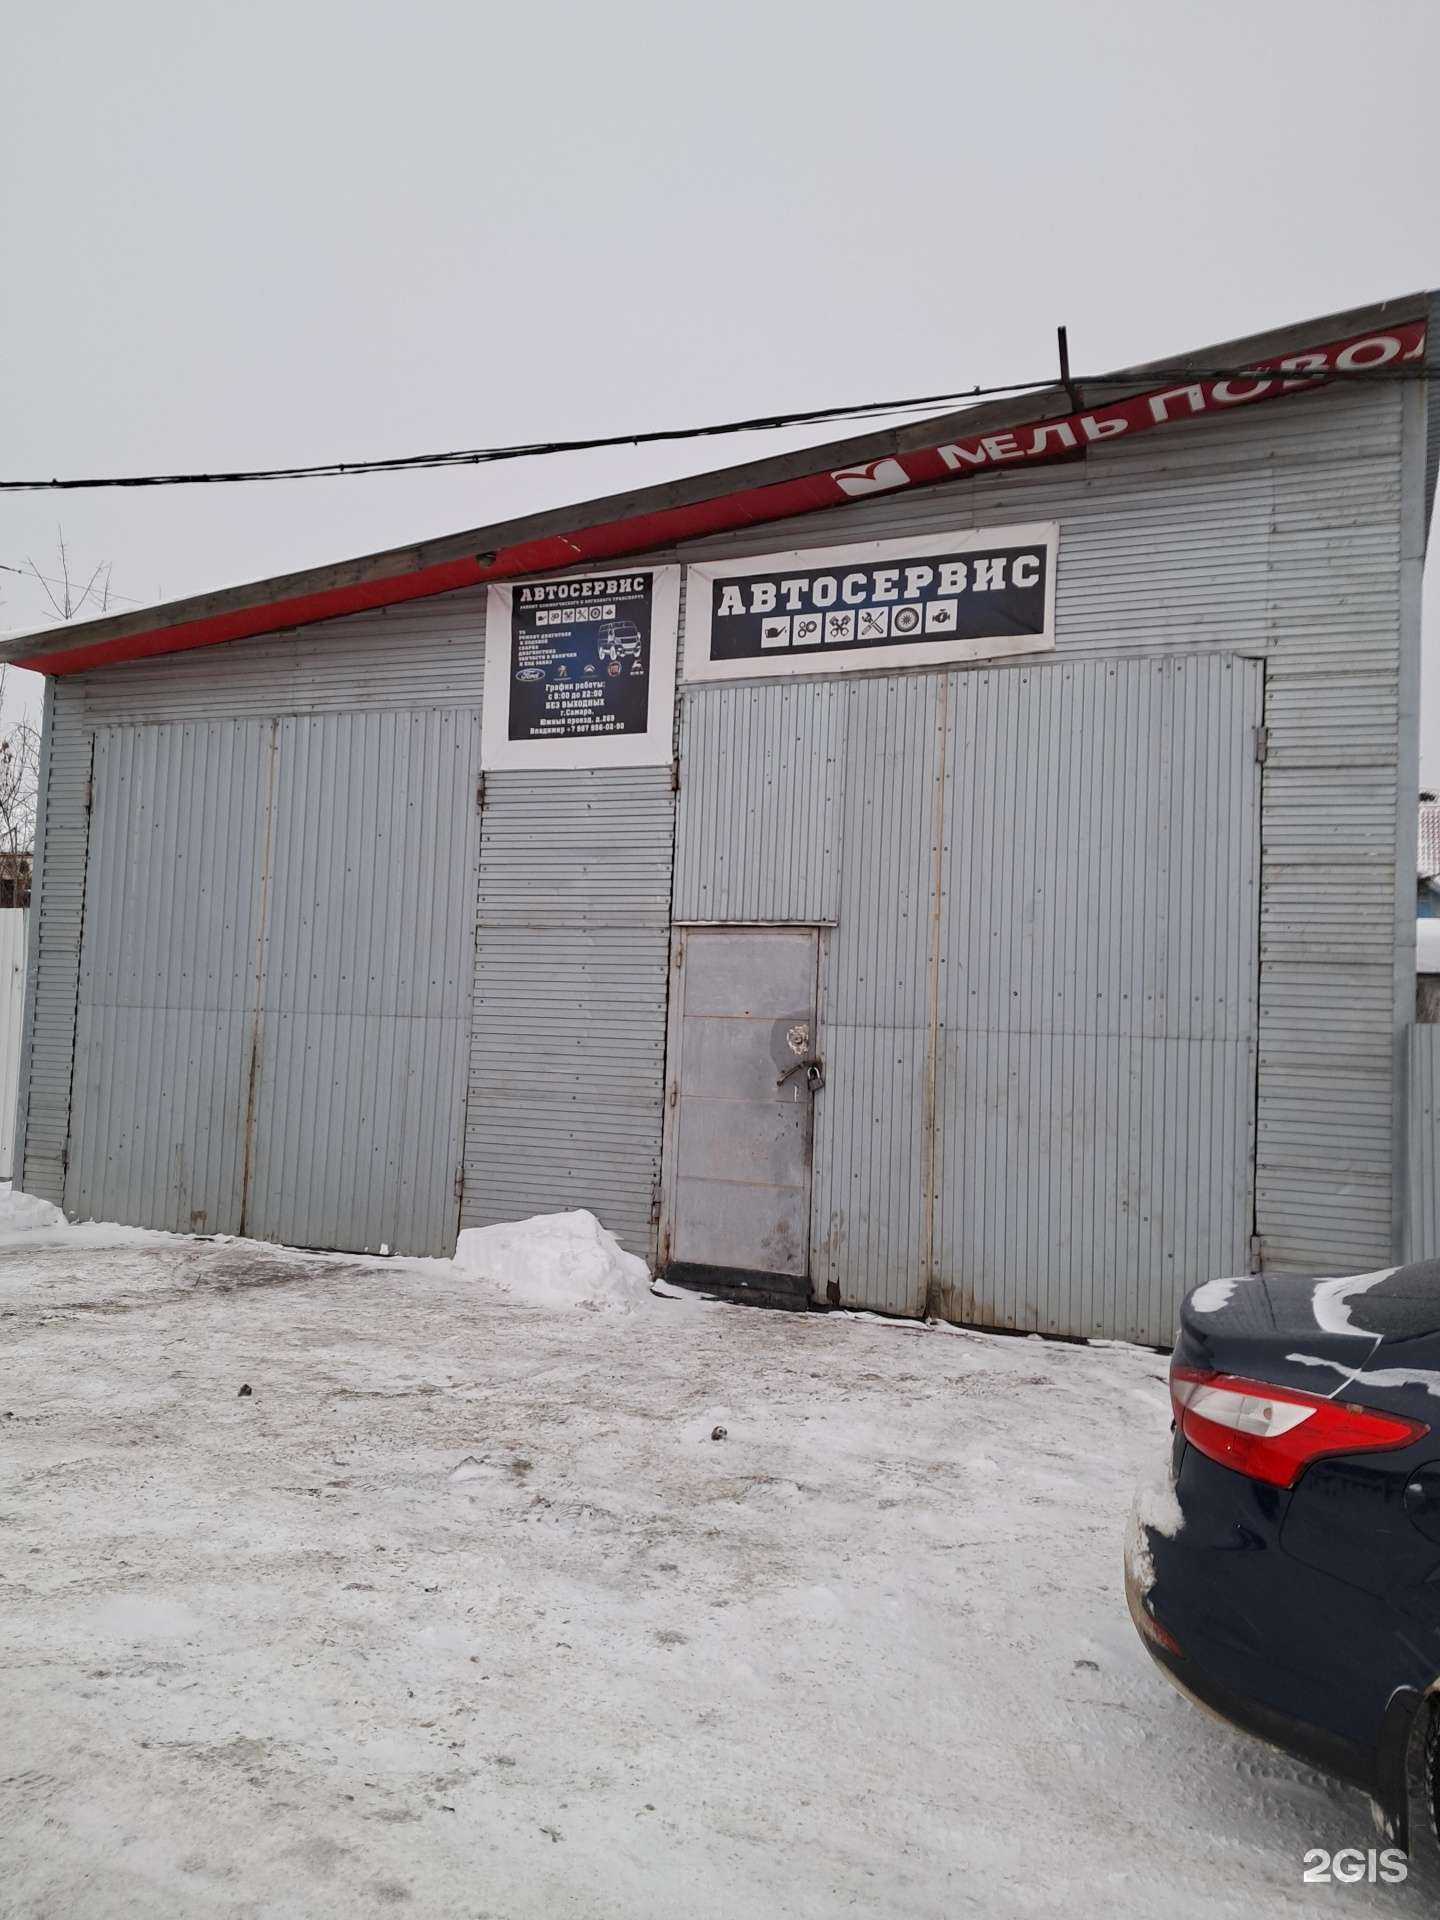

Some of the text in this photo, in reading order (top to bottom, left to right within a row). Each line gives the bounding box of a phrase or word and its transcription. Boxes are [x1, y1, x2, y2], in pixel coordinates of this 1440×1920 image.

[936, 416, 1129, 471] МЕЛЬ
[520, 577, 644, 602] АВТОСЕРВИС
[717, 555, 1041, 616] АВТОСЕРВИС
[545, 683, 573, 692] График
[545, 699, 605, 709] БЕЗ ВЫХОДНЫХ
[540, 718, 565, 726] Южный
[530, 726, 565, 735] Владимир
